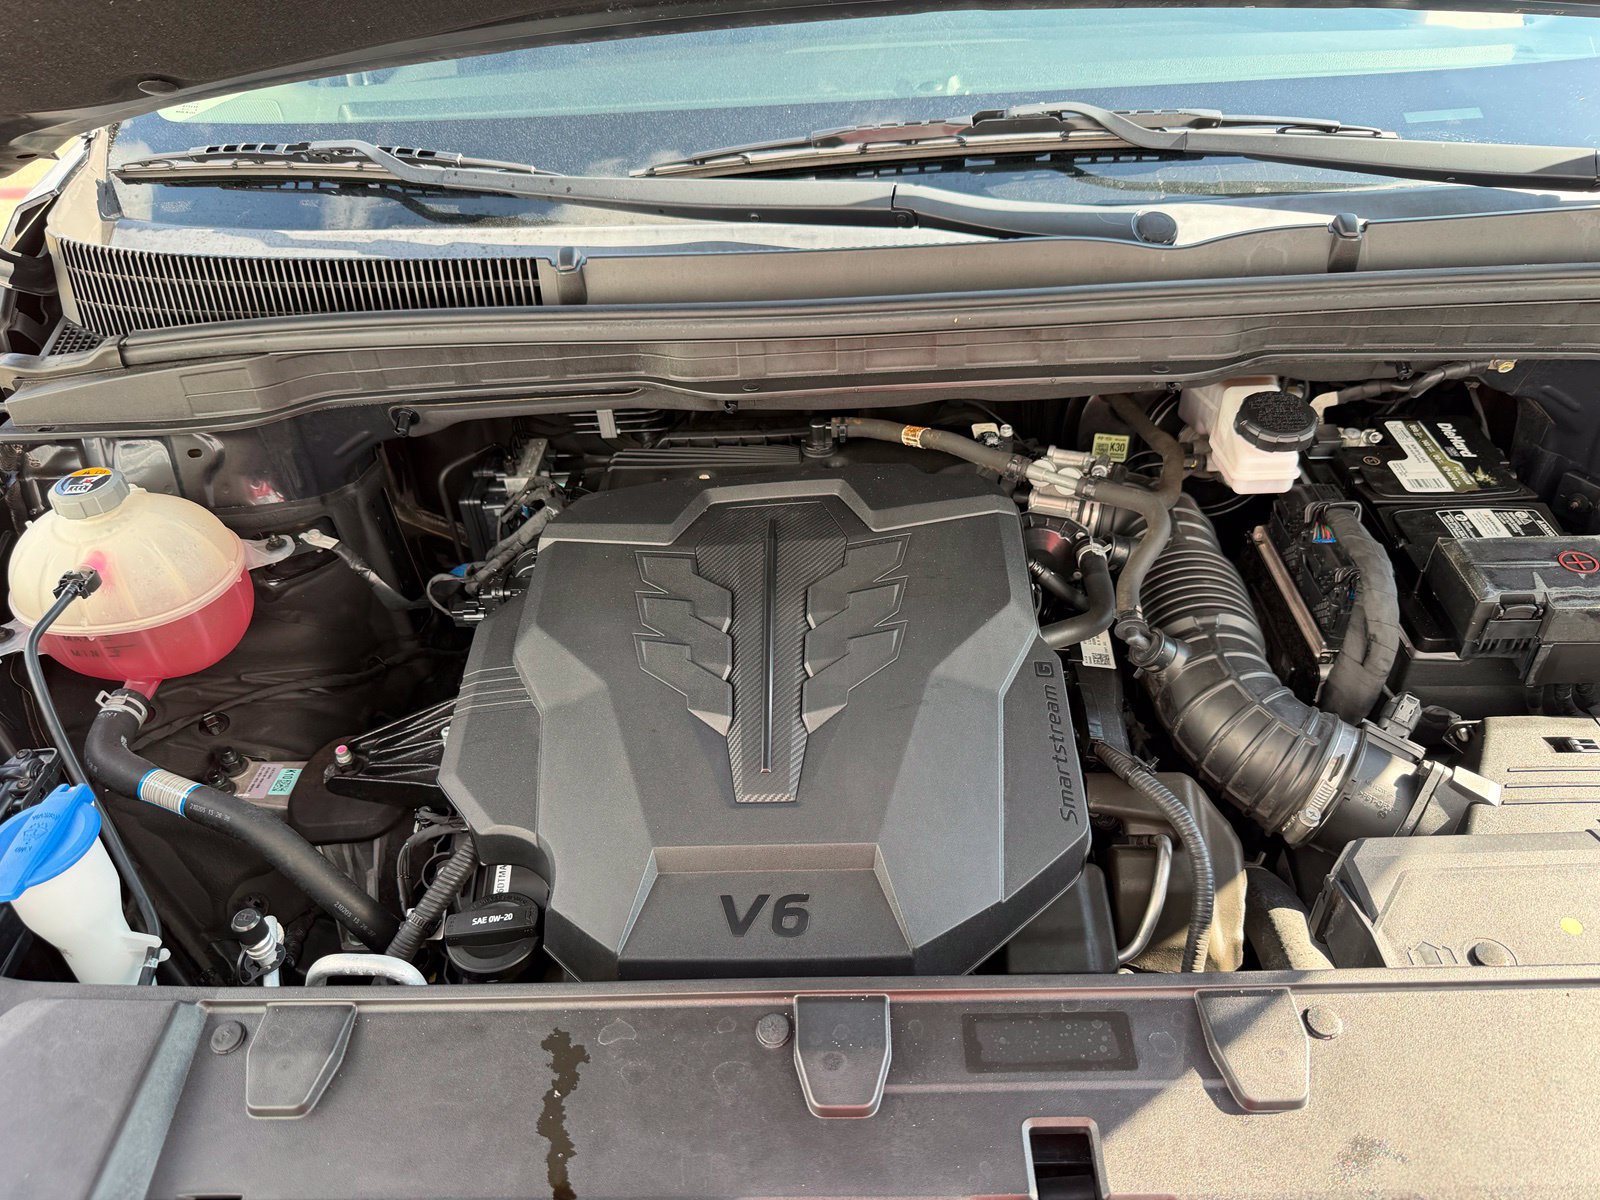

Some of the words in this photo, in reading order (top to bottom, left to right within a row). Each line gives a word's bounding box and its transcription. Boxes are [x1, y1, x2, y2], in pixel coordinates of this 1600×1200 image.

[1110, 441, 1126, 452] K30
[1436, 422, 1478, 458] DieHard
[1044, 684, 1079, 825] Smartstream
[471, 916, 487, 926] SAE
[488, 912, 514, 923] 0W-20
[720, 894, 810, 937] V6
